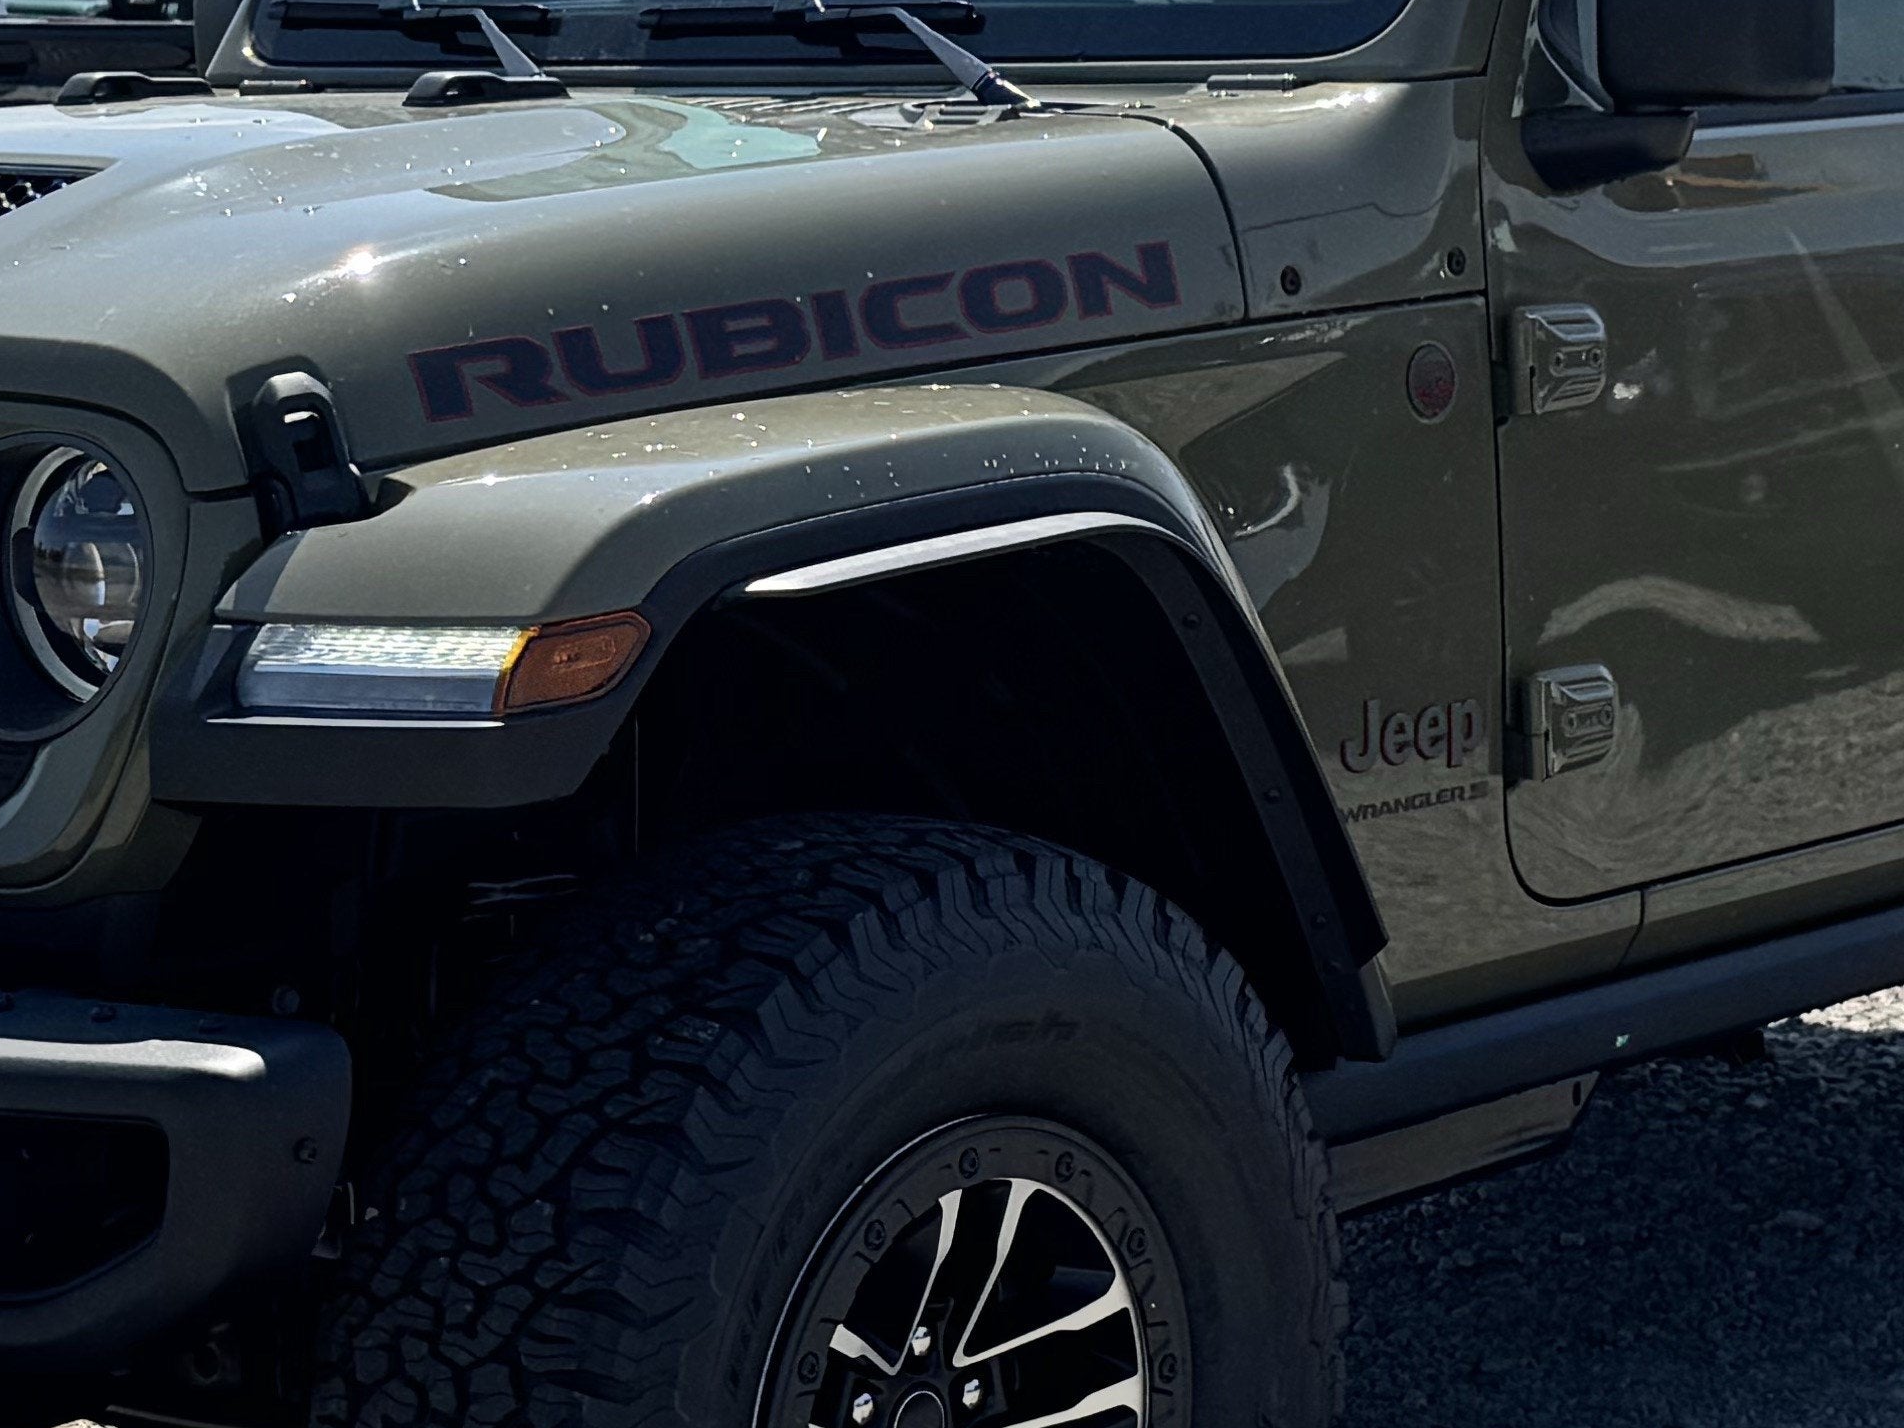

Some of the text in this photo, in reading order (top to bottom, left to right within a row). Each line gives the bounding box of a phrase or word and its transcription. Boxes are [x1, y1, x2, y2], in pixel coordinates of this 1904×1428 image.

[406, 240, 1182, 423] RUBICON
[1339, 697, 1485, 773] Jeep
[1340, 785, 1466, 823] WRANGLER
